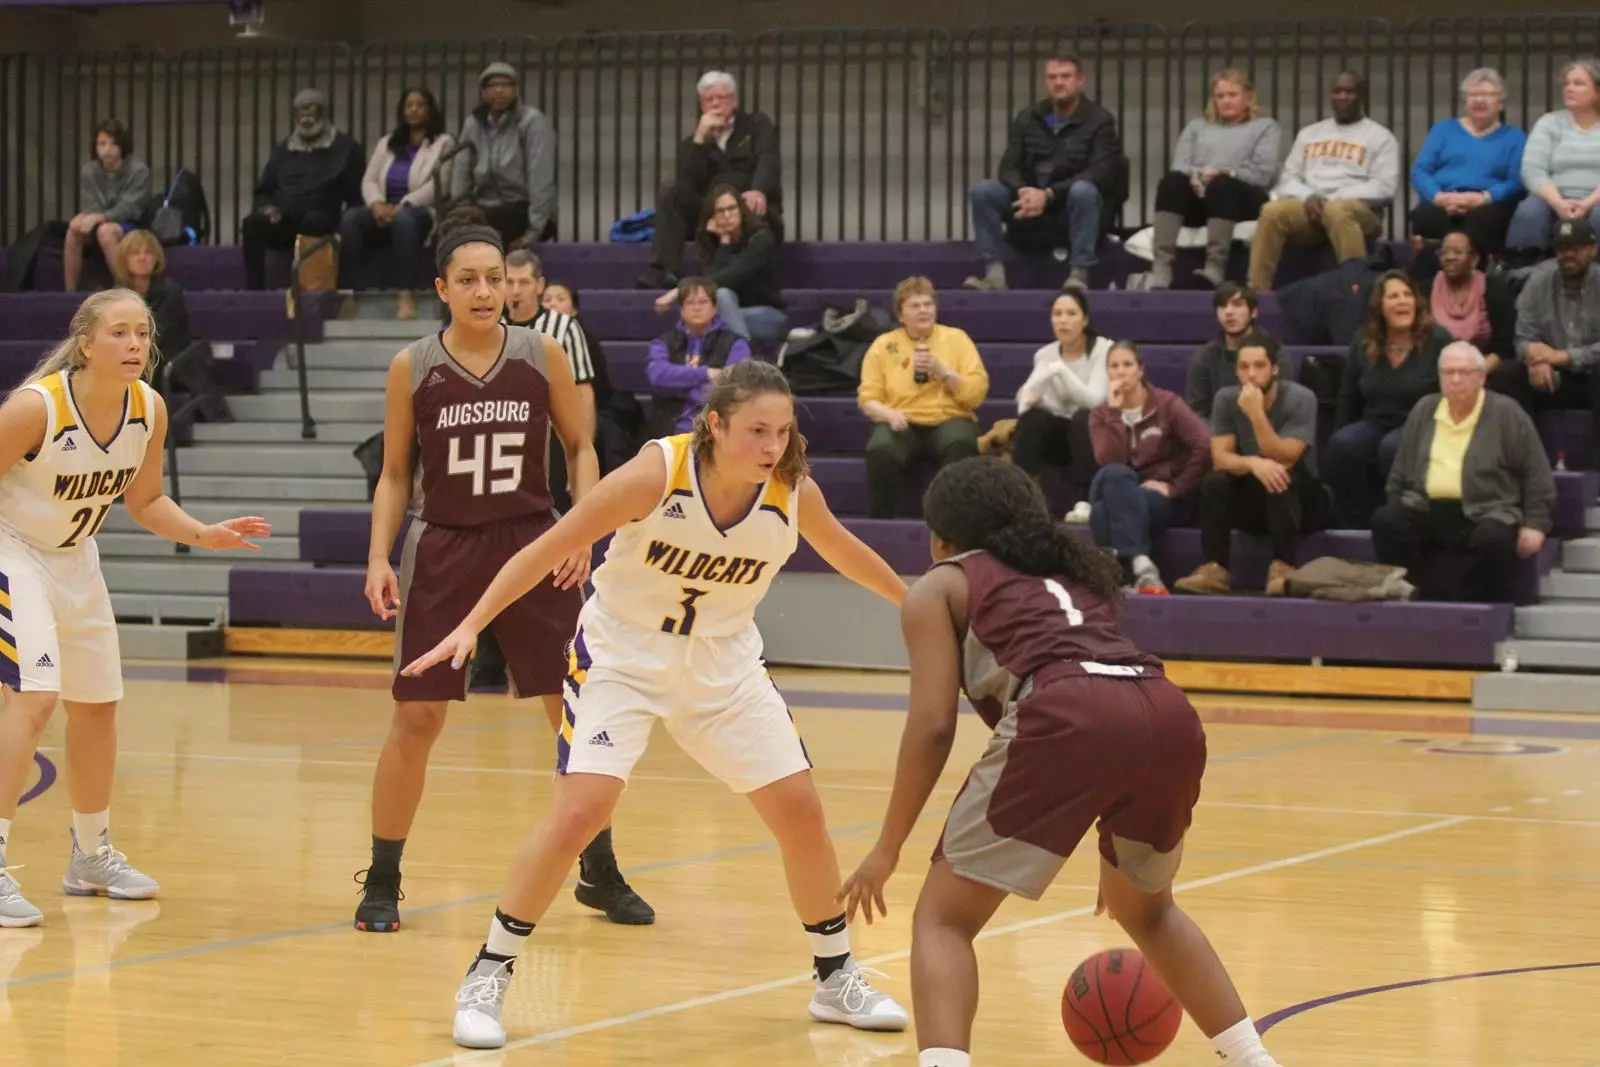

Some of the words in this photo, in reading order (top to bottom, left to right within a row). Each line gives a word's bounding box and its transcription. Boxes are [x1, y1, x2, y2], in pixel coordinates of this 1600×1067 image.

[435, 401, 530, 430] AUGSBURG
[53, 466, 138, 501] WILDCAT
[447, 432, 526, 497] 45
[644, 539, 769, 585] WILDCATS
[661, 586, 709, 636] 3
[1043, 578, 1084, 627] 1
[588, 739, 614, 747] adidas
